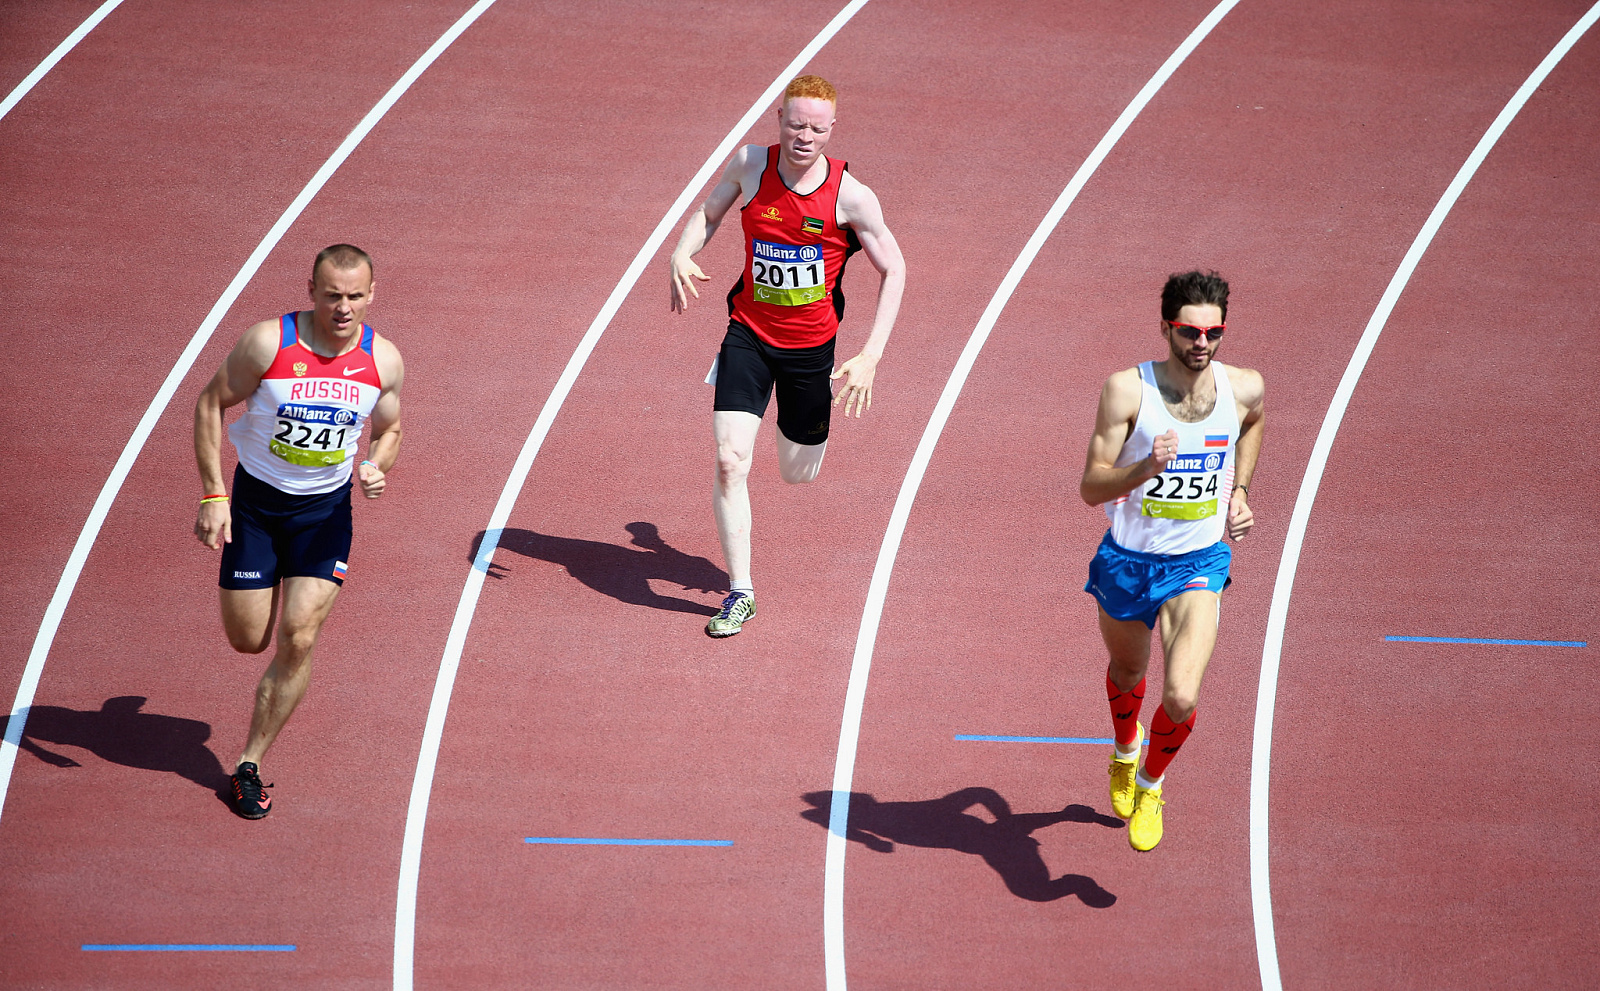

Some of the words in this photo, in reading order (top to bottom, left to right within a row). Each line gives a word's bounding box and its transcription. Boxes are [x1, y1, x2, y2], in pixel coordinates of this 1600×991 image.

[755, 242, 797, 259] Allianz
[754, 261, 818, 287] 2011
[291, 381, 359, 405] RUSSIA
[282, 406, 332, 421] Allianz
[275, 420, 346, 450] 2241
[1167, 458, 1202, 470] lianz
[1146, 474, 1218, 499] 2254
[234, 570, 261, 579] RUSSIA
